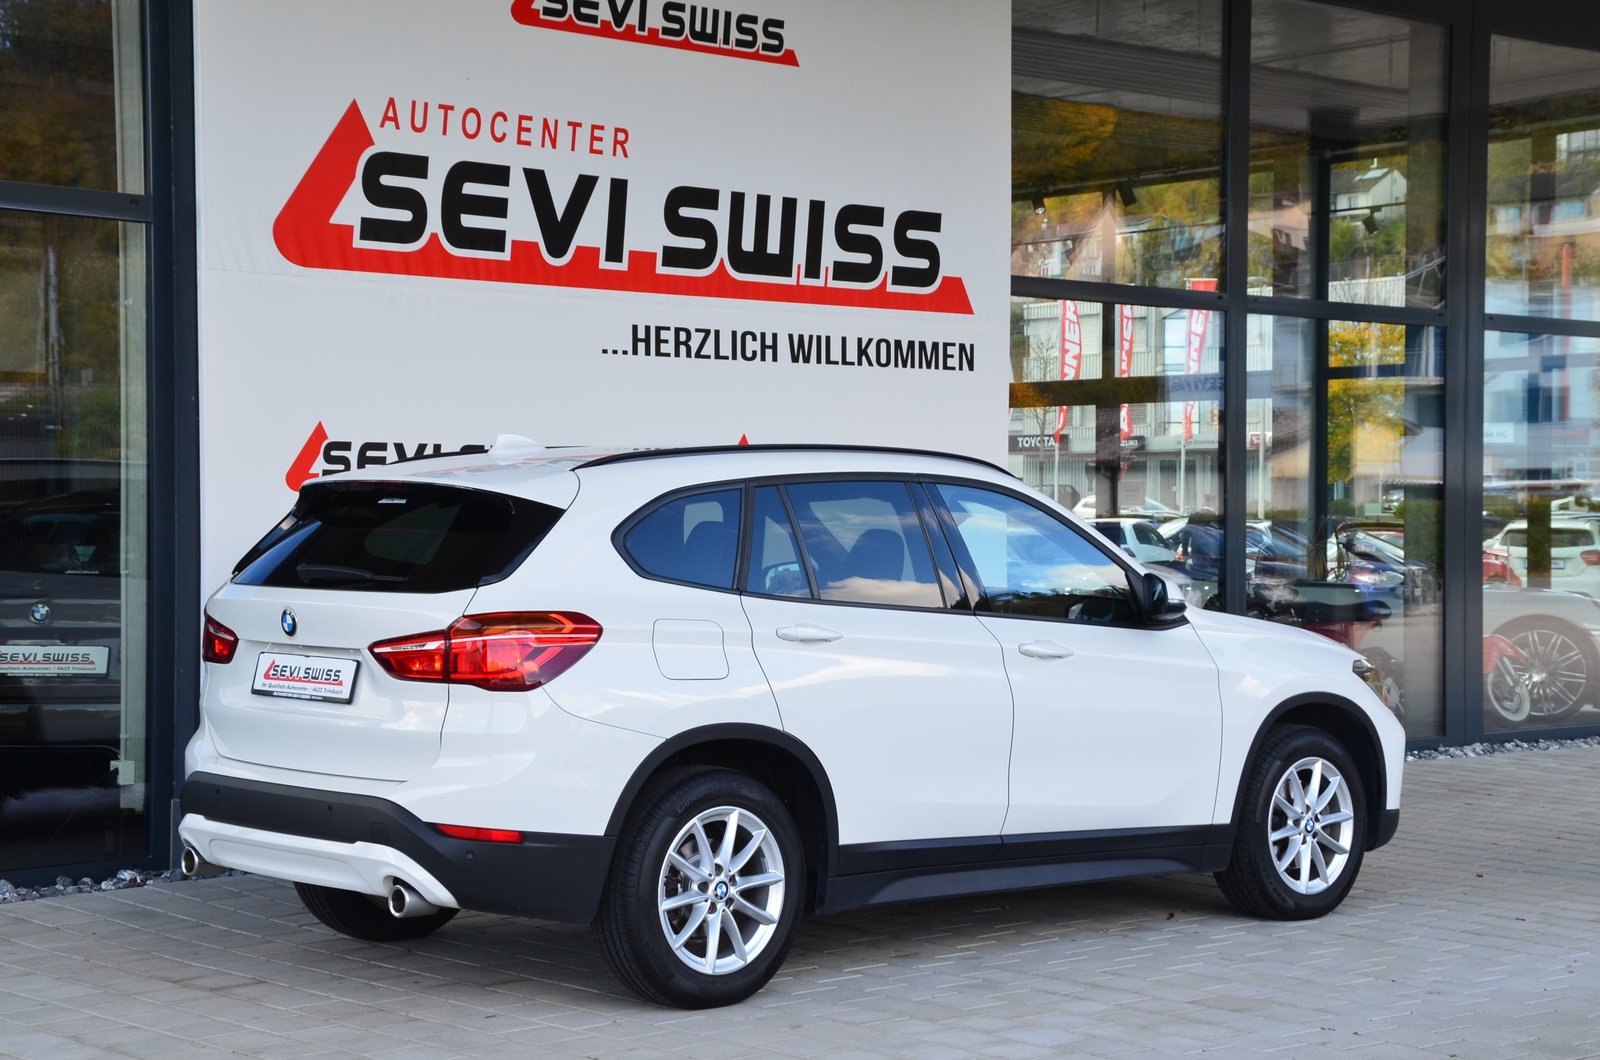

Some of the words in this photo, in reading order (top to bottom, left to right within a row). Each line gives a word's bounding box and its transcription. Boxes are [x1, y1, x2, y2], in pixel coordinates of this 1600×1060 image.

[661, 1, 785, 54] SWISS
[379, 97, 631, 159] AUTOCENTER
[359, 151, 629, 264] SEVI
[661, 185, 943, 289] SWISS
[788, 333, 976, 372] WILLKOMMEN
[1120, 439, 1138, 448] ZUKI
[41, 652, 91, 663] SWISS
[271, 664, 301, 679] SEVI
[302, 666, 342, 683] SWISS
